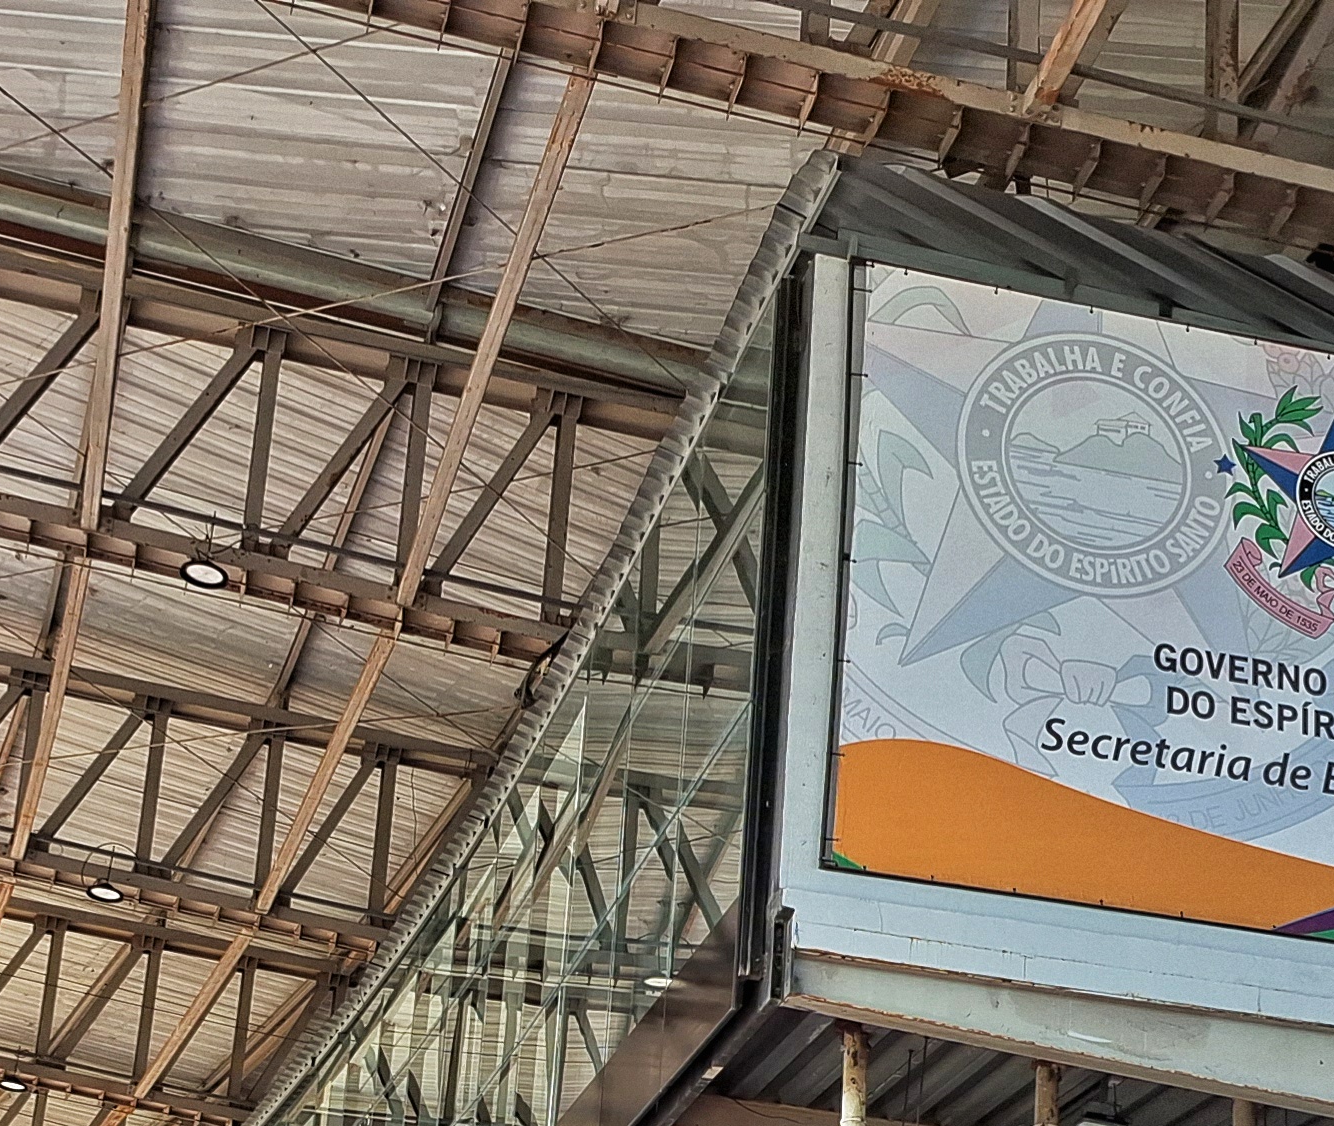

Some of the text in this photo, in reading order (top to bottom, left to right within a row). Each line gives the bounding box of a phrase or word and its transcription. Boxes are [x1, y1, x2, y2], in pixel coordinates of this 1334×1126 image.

[980, 345, 1213, 453] TRABALHA E CONFIA
[971, 460, 1031, 541] ESTADO
[1026, 533, 1065, 569] DO
[1166, 496, 1220, 563] SANTO
[1301, 499, 1324, 532] ESTADO
[1232, 560, 1244, 573] 23
[1241, 572, 1256, 589] DE
[1254, 585, 1279, 608] MAIO
[1278, 605, 1295, 620] DE
[1153, 643, 1327, 697] GOVERNO
[1167, 686, 1215, 719] DO
[1040, 718, 1252, 782] Secretaria
[1262, 752, 1312, 790] de
